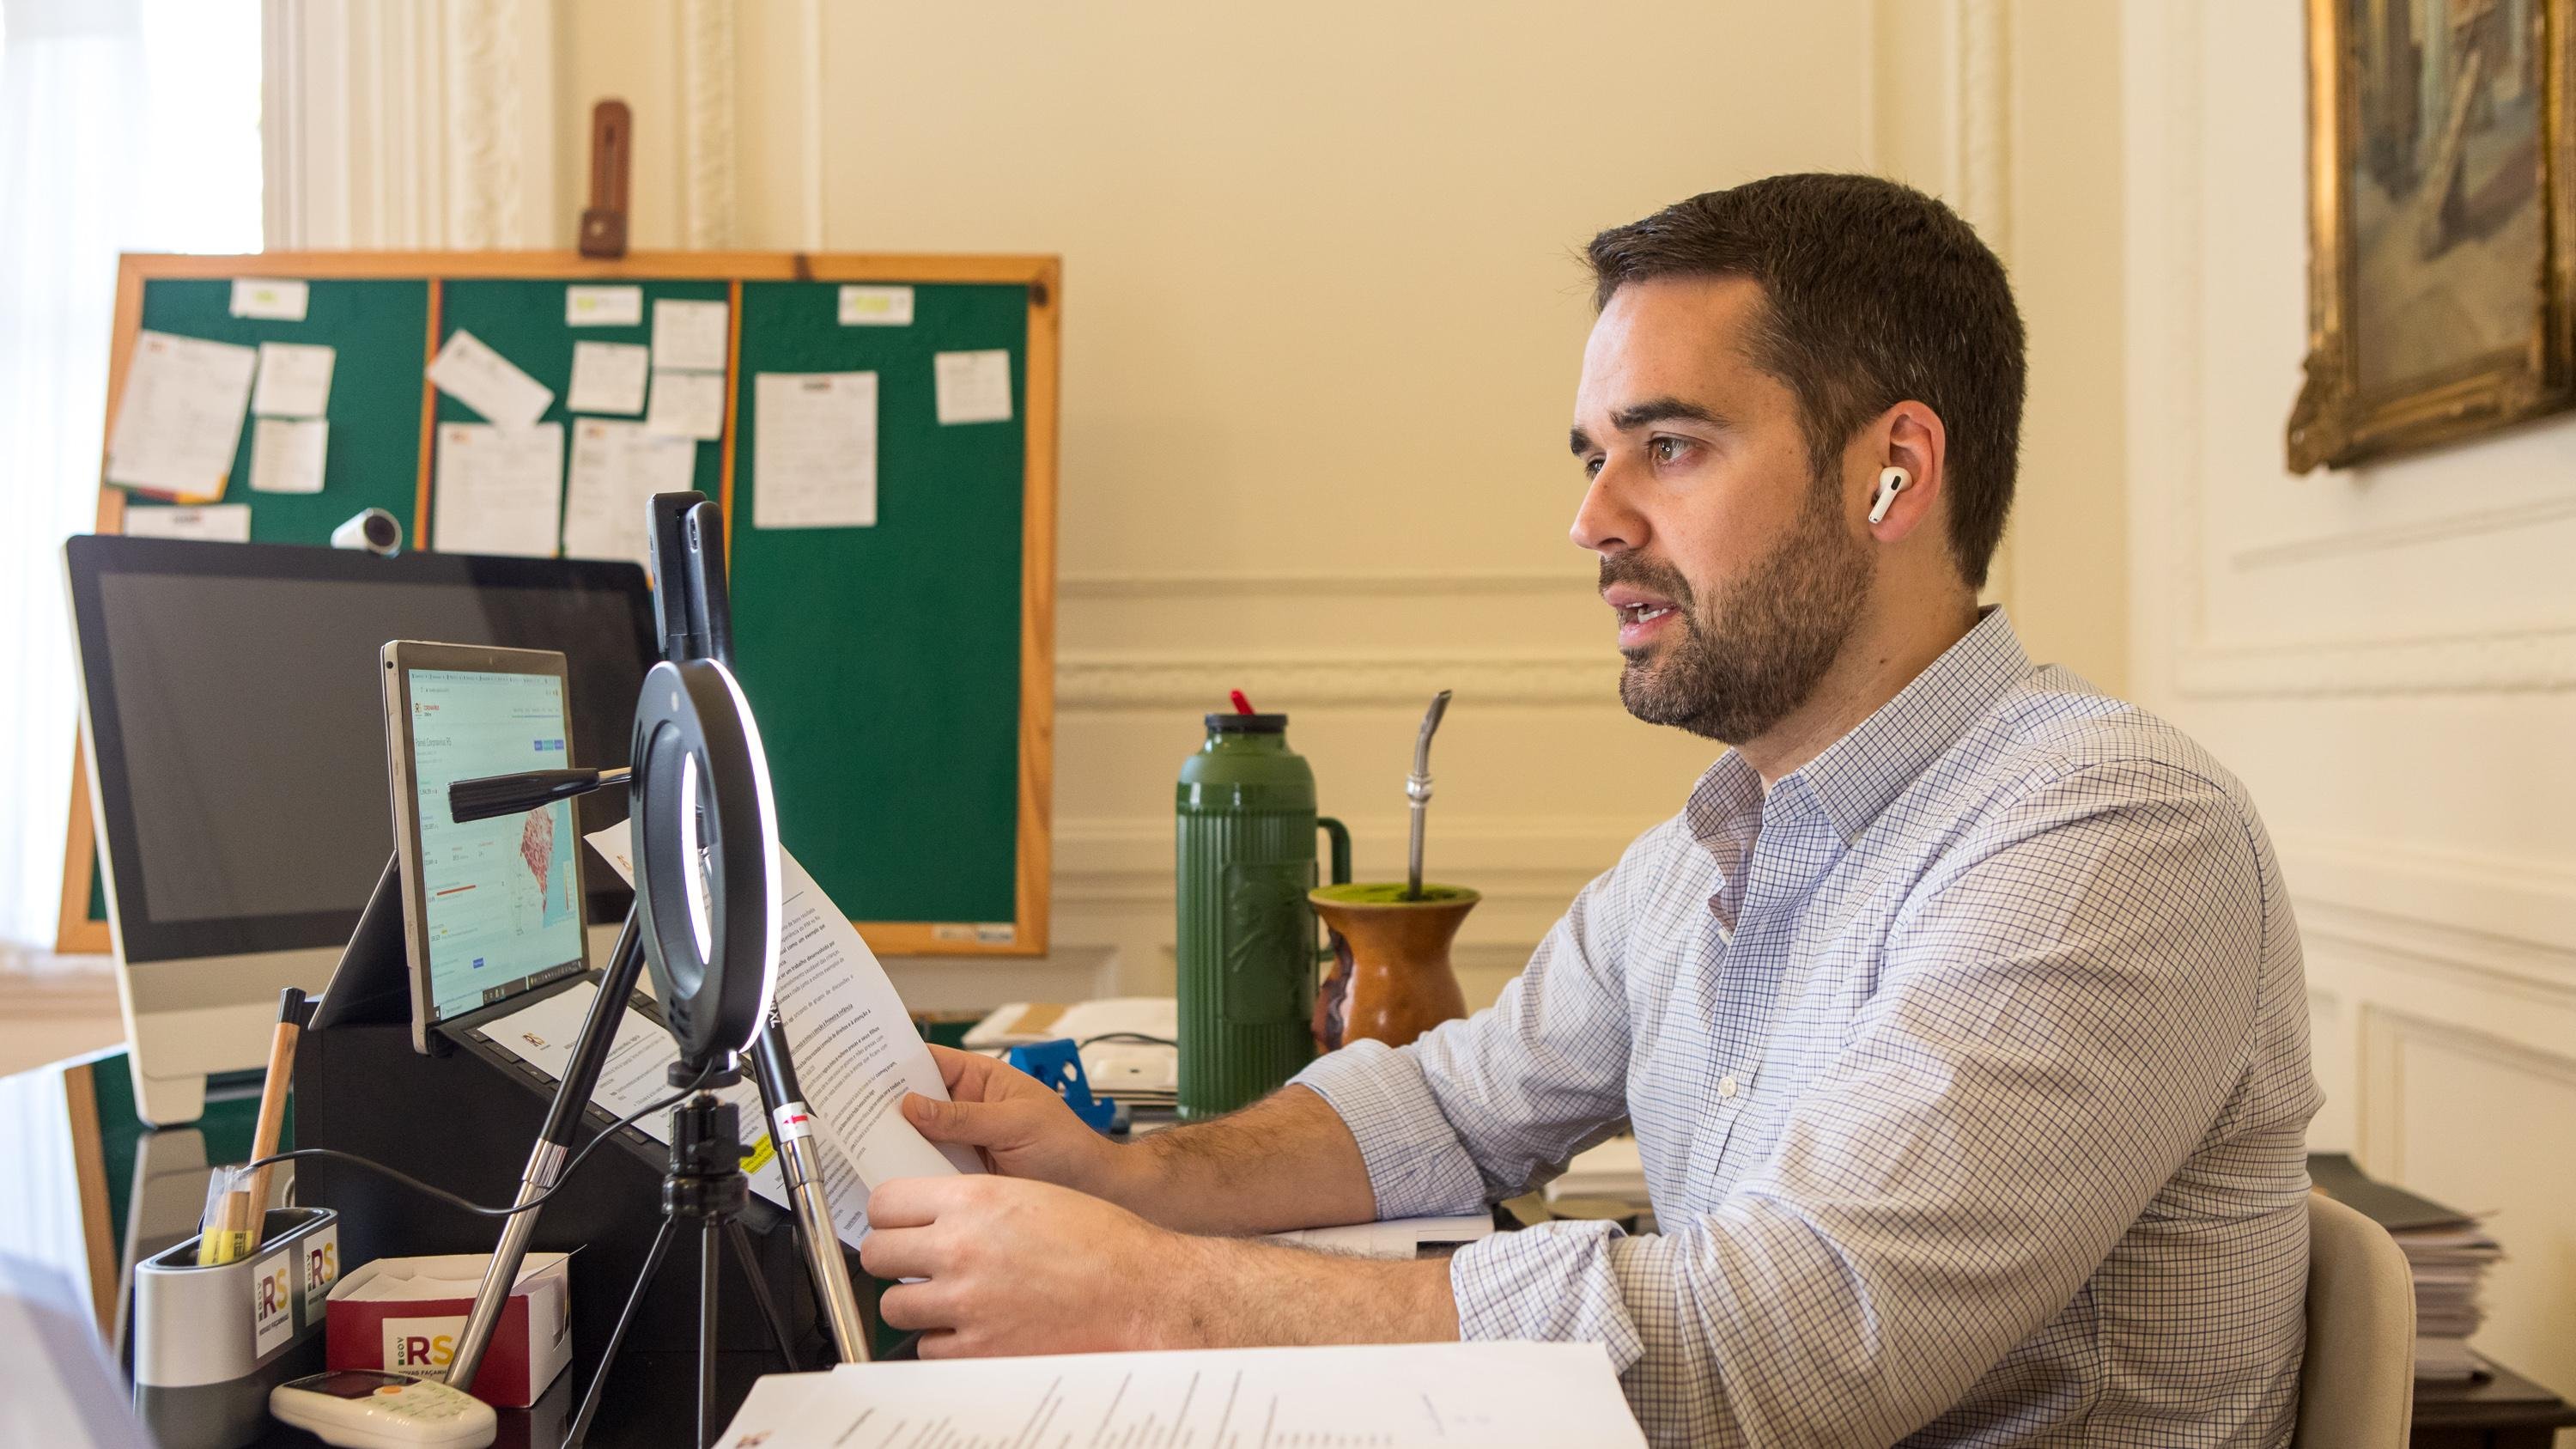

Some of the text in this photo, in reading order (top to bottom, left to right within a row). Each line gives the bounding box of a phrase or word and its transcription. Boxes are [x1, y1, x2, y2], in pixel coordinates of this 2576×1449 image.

[781, 928, 799, 943] xperiência
[787, 941, 798, 951] como
[805, 928, 819, 940] exemplo
[792, 959, 807, 971] trabalho
[835, 1025, 848, 1036] direitos
[311, 1242, 335, 1289] RS
[262, 1268, 288, 1319] RS
[406, 1335, 454, 1366] RS
